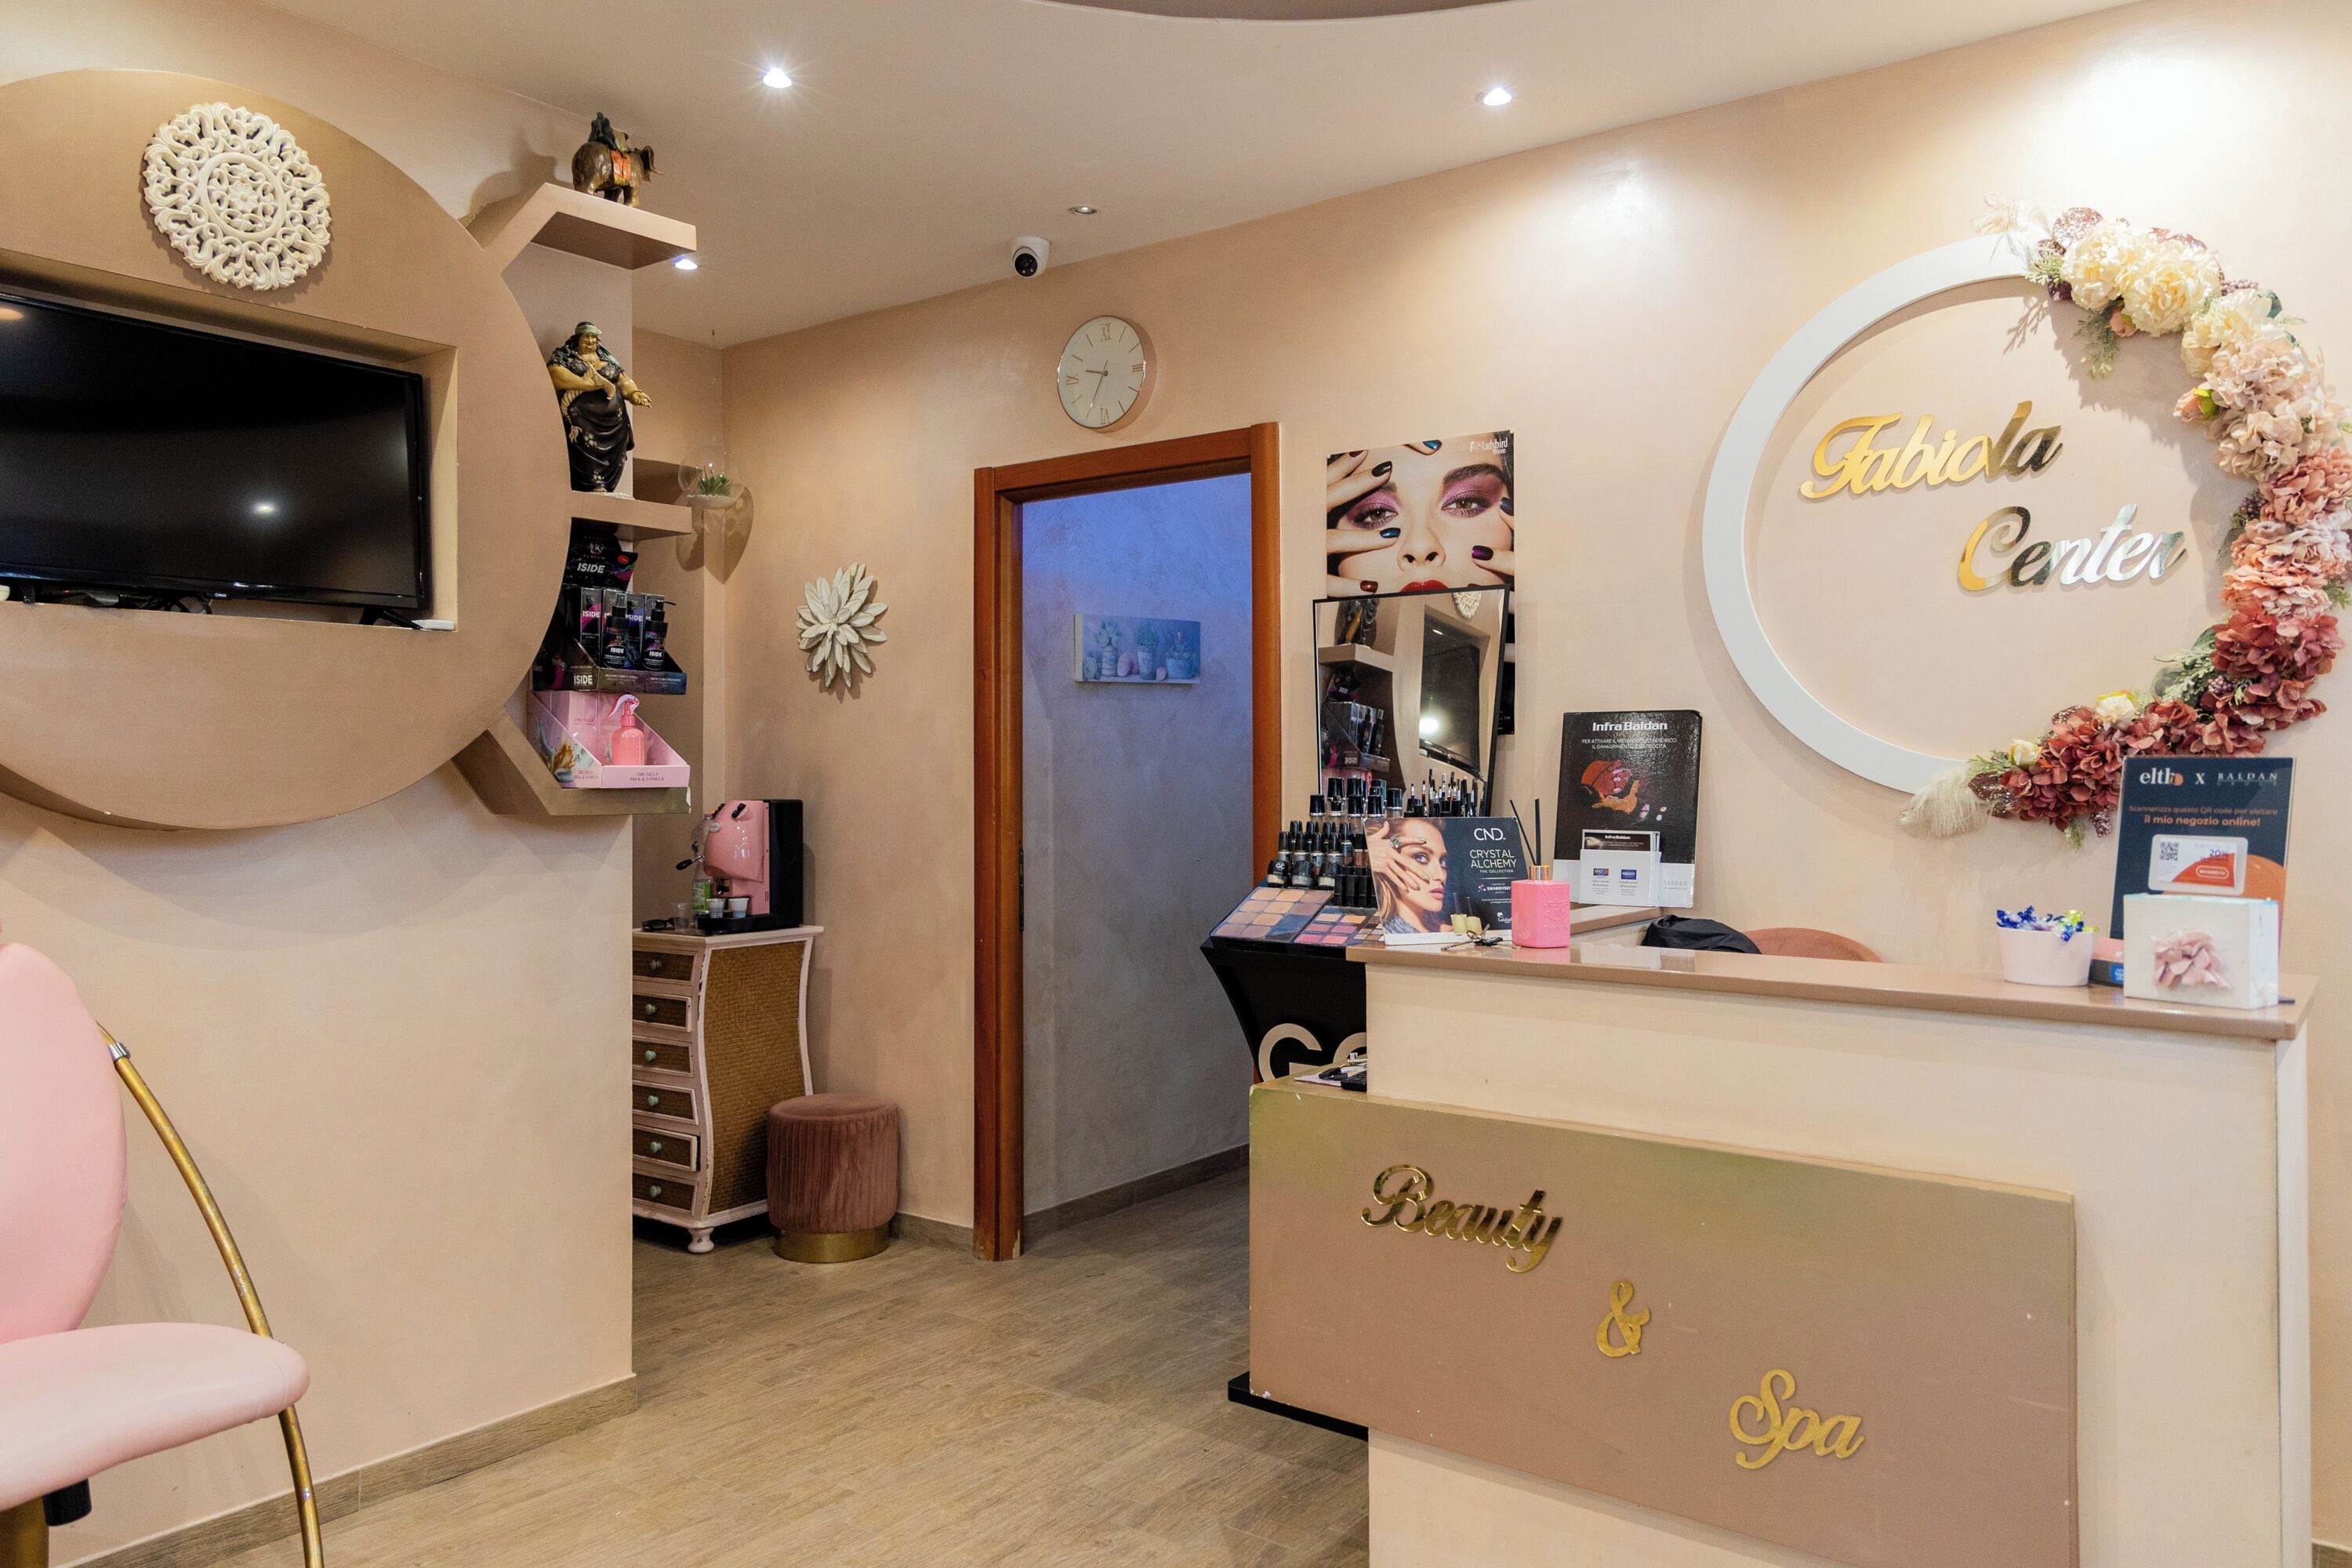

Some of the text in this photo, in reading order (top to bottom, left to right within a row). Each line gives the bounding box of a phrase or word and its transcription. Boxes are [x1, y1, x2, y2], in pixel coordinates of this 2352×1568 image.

[1800, 401, 2063, 499] Fabiola
[1958, 503, 2187, 591] Center
[577, 563, 605, 573] ISIDE
[573, 675, 593, 684] ISIDE
[1592, 720, 1668, 731] Infra Baldan
[2153, 815, 2172, 824] mio
[2176, 816, 2219, 827] negozio
[2222, 817, 2261, 826] online!
[1469, 849, 1515, 858] CRYSTAL
[1471, 859, 1516, 869] ALCHEMY
[1361, 1164, 1563, 1273] Beauty
[1595, 1279, 1651, 1357] &
[1730, 1369, 1865, 1469] Spa
